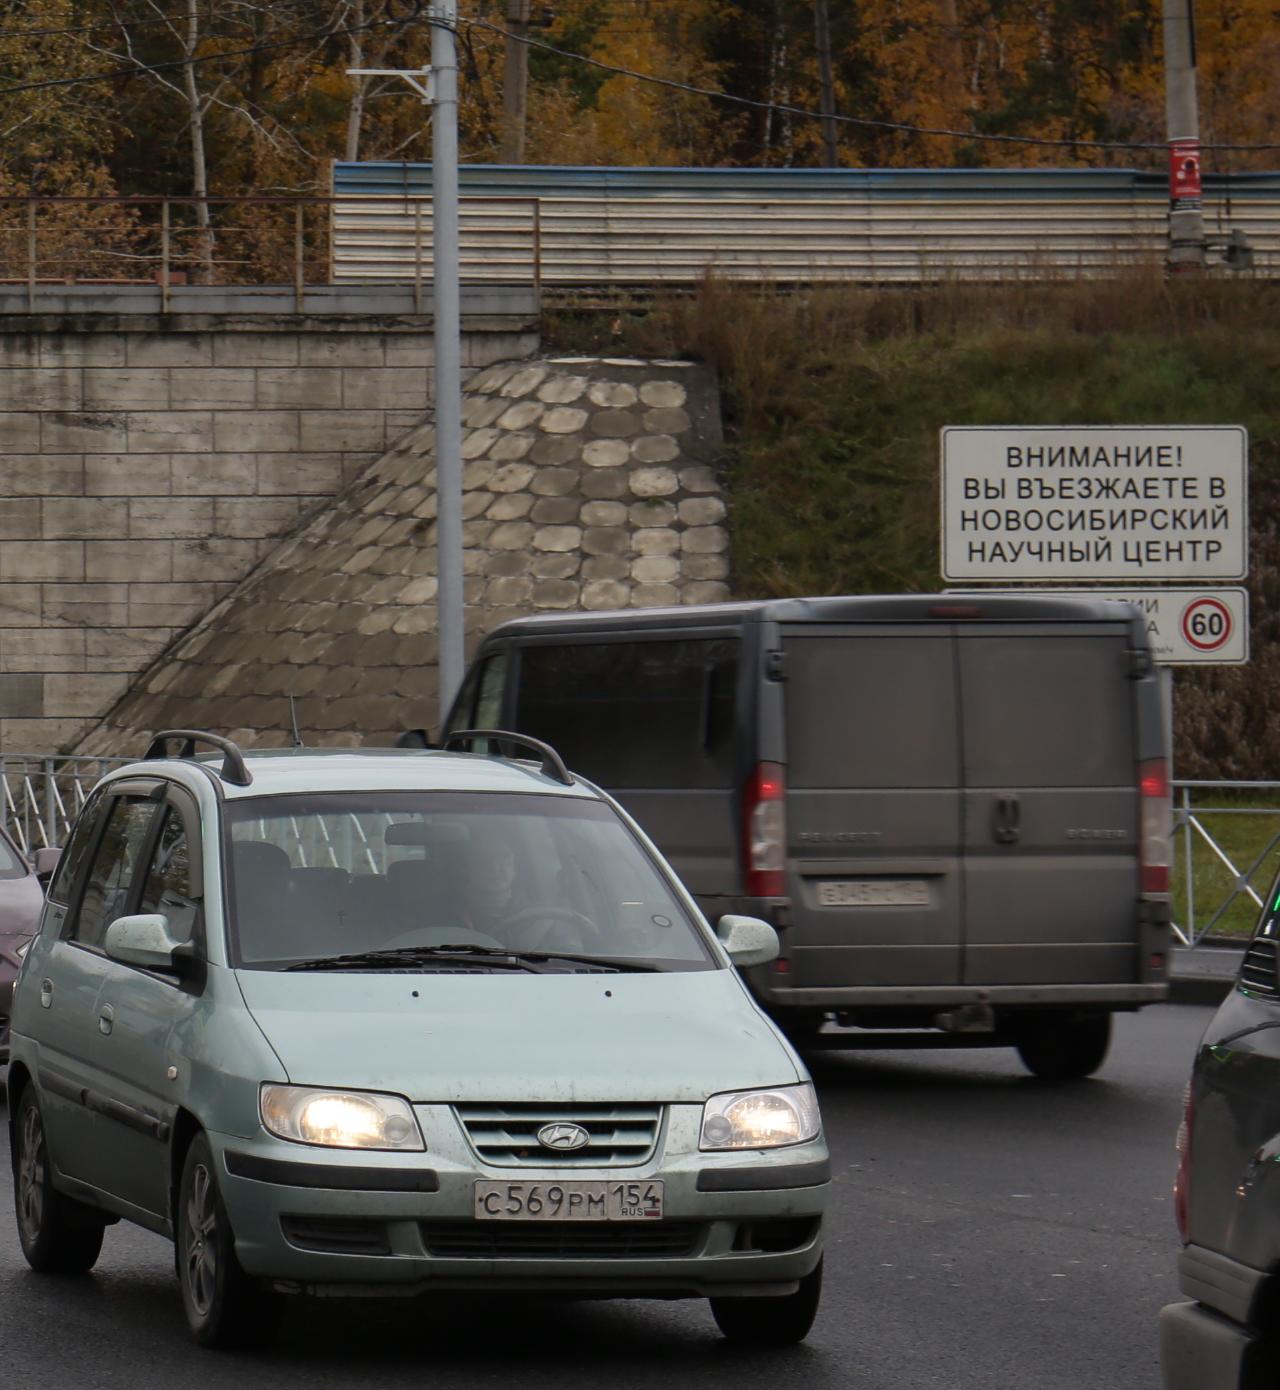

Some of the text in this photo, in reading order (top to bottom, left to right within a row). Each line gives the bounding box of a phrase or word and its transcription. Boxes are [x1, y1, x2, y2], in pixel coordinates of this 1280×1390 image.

[1006, 445, 1184, 468] ВНИМАНИЕ!
[963, 476, 1227, 500] ВЫ ВЪЕЗЖАЕТЕ В
[960, 504, 1229, 531] НОВОСИБИРСКИЙ
[968, 536, 1224, 568] НАУЧНЫЙ ЦЕНТР
[1191, 612, 1224, 637] 60
[621, 1207, 644, 1217] RUS
